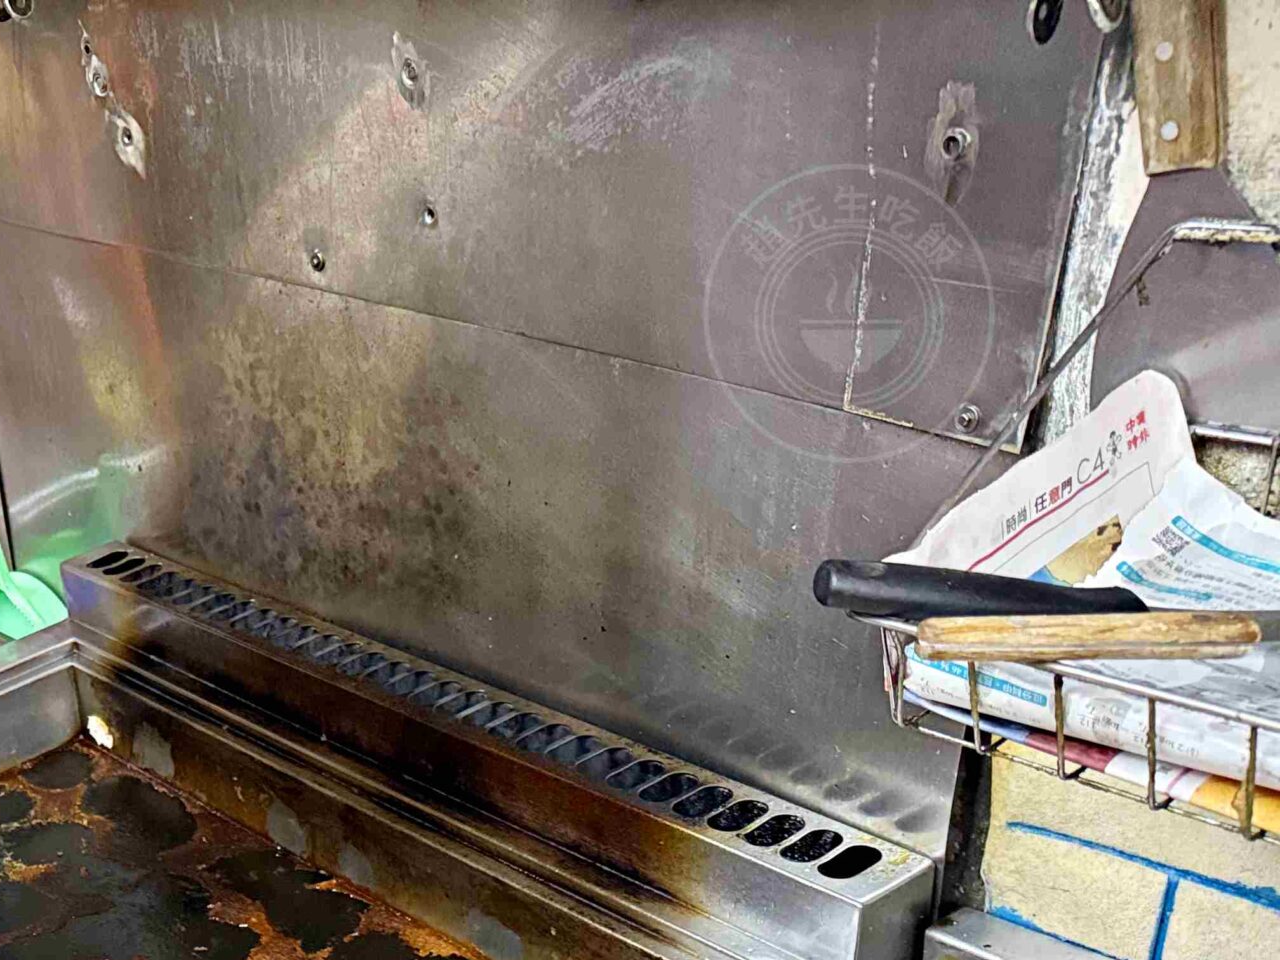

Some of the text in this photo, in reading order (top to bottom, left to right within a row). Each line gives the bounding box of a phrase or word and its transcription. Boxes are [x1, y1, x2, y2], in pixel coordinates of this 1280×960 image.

[1005, 447, 1105, 535] 時尚 任意門 C4
